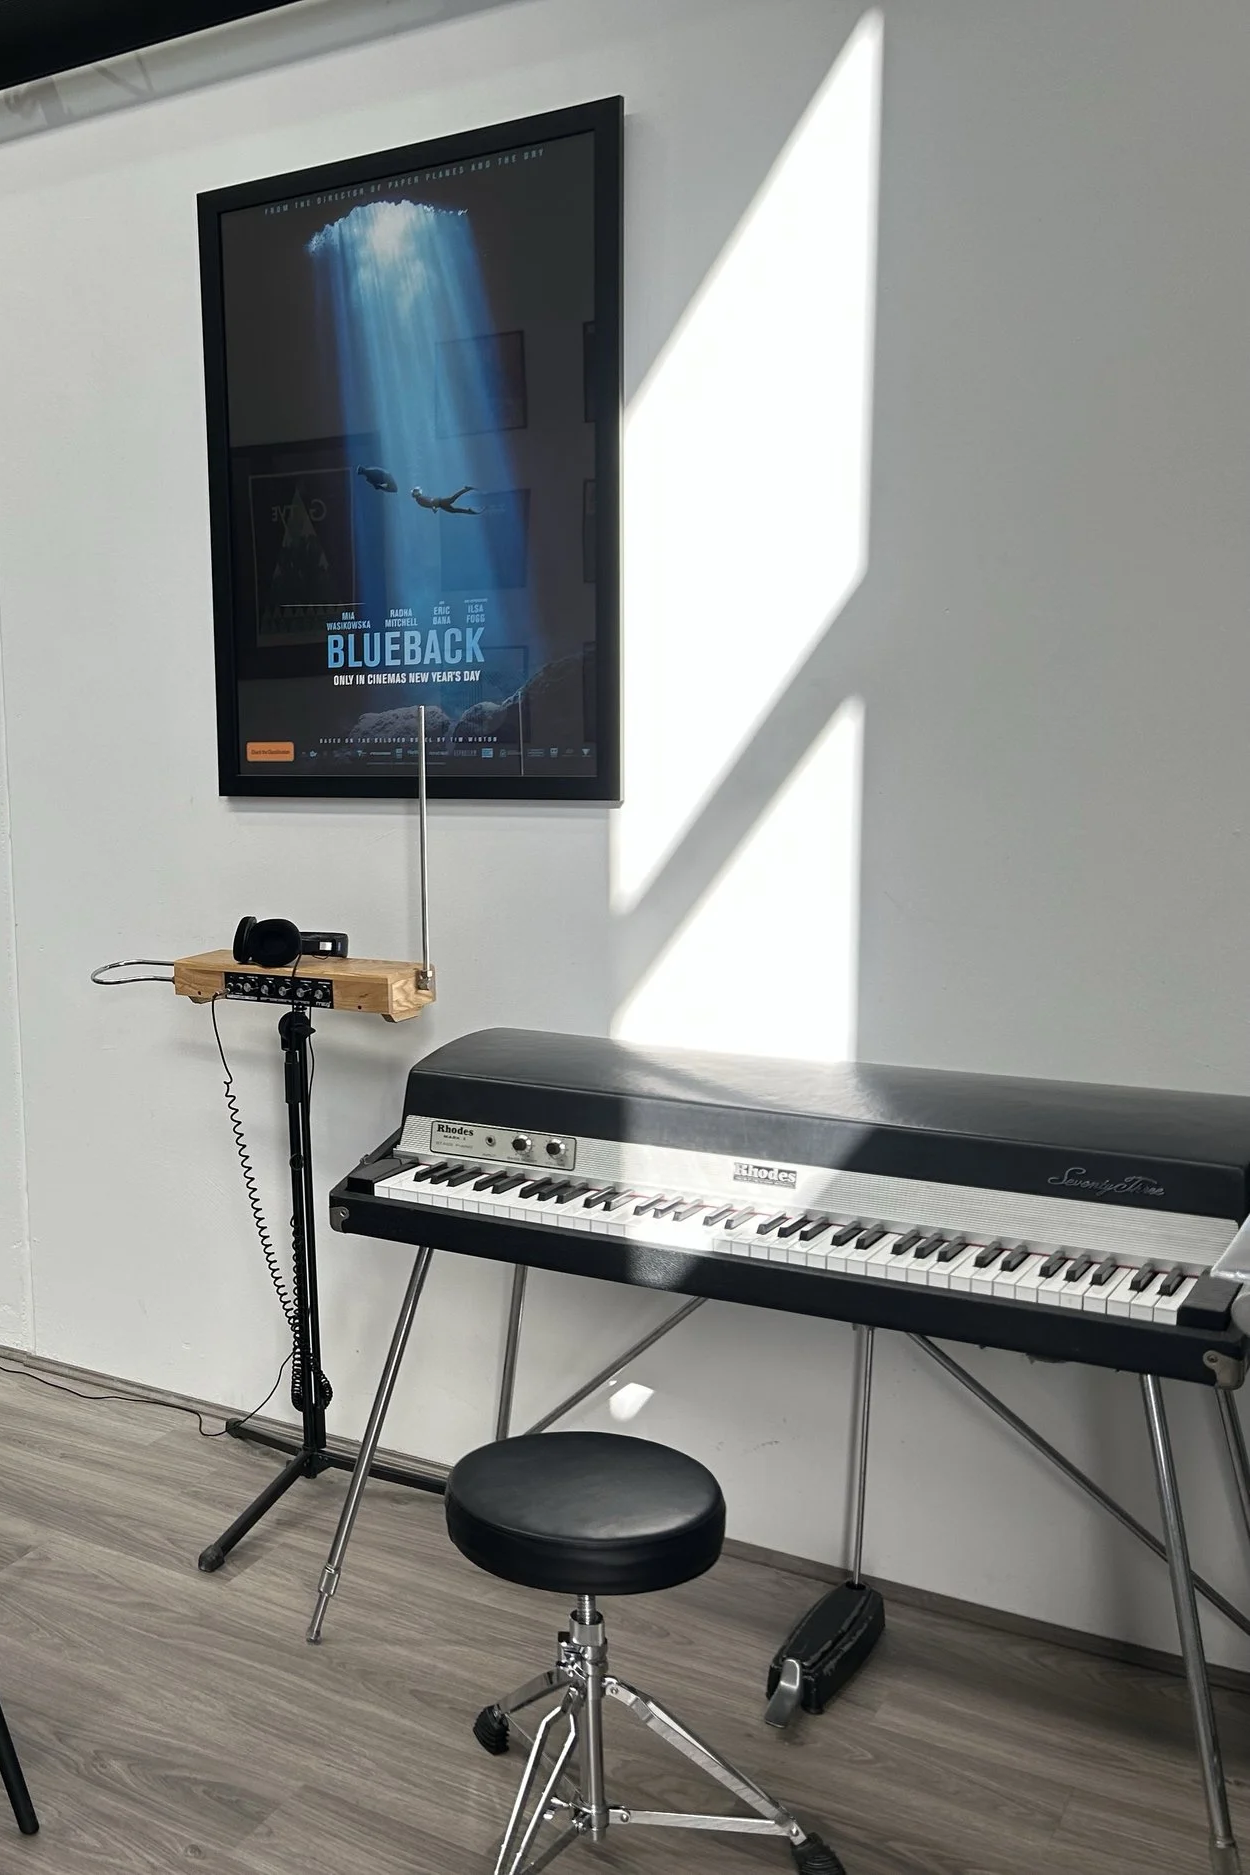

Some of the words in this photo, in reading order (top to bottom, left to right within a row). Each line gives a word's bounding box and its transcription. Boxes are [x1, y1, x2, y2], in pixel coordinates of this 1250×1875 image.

[388, 176, 420, 190] PAPER
[426, 166, 465, 181] PLANES
[390, 608, 413, 617] RADHA
[433, 606, 450, 615] ERIC
[467, 604, 484, 613] ILSA
[341, 612, 355, 621] MIA
[432, 616, 451, 625] BANA
[326, 620, 371, 631] WASIKOWSKA
[385, 617, 418, 628] MITCHELL
[327, 627, 485, 668] BLUEBACK
[333, 674, 353, 686] ONLY
[356, 674, 365, 685] IN
[367, 673, 407, 685] CINEMAS
[409, 672, 429, 683] NEW
[431, 671, 461, 683] YEAR'S
[463, 670, 481, 682] DAY
[437, 1123, 474, 1136] Rhodes
[734, 1163, 796, 1183] Rhodes
